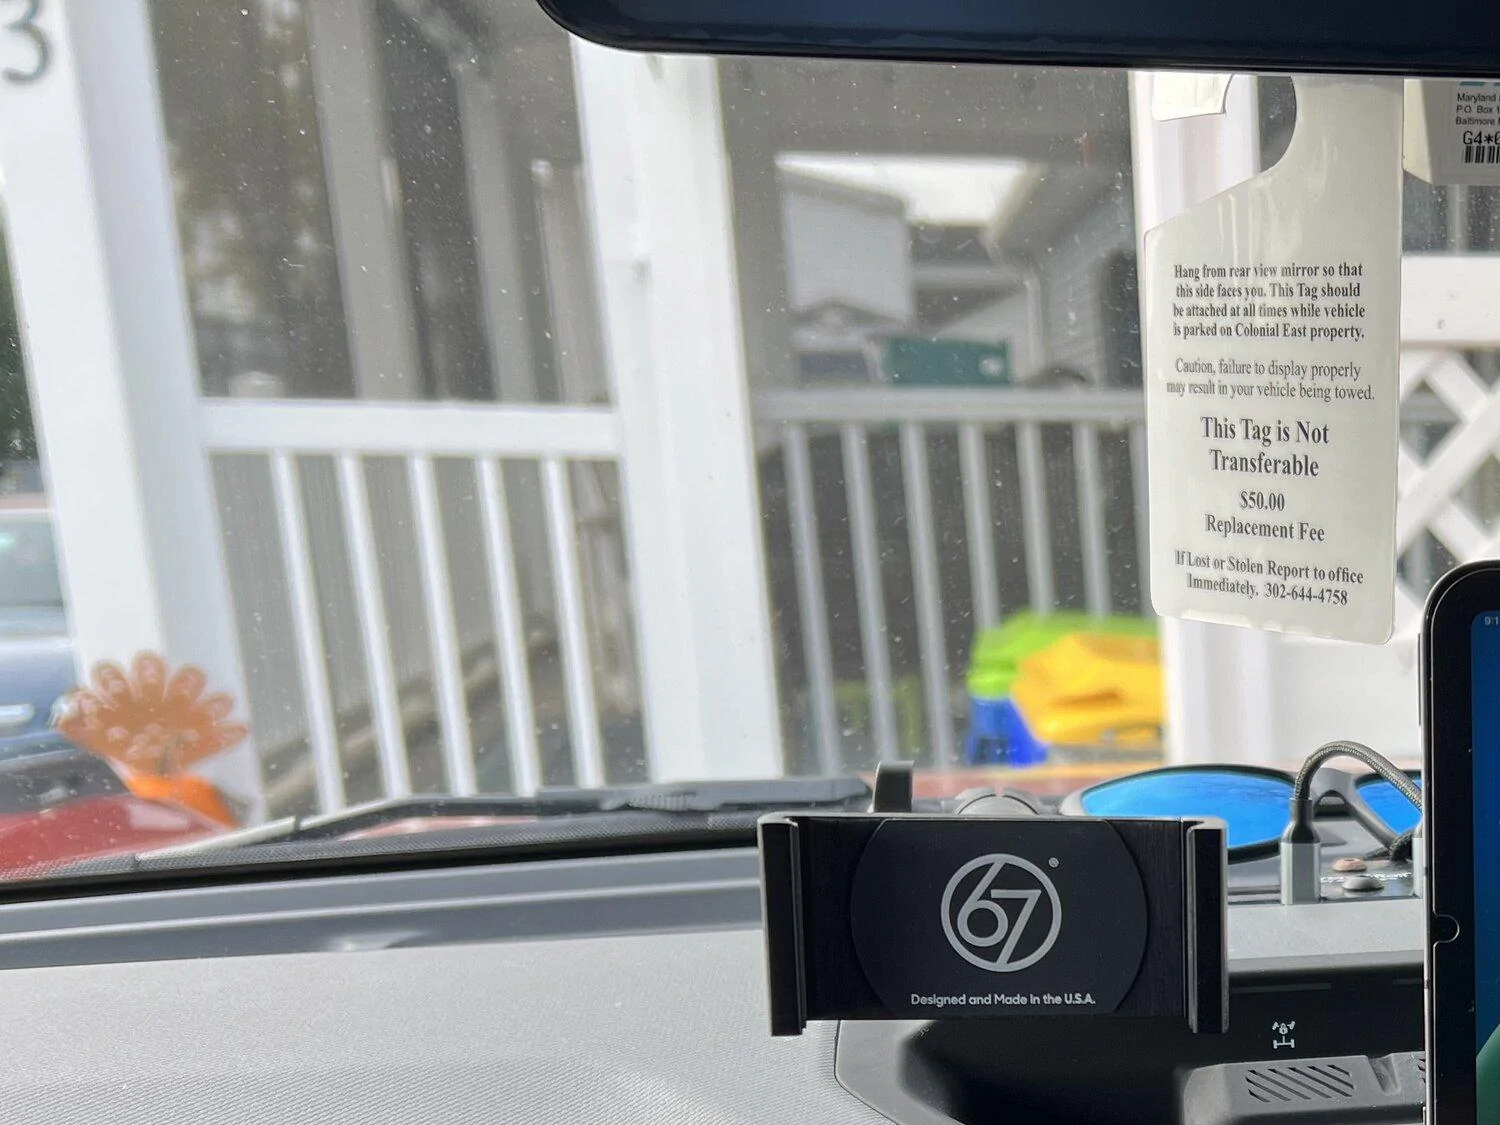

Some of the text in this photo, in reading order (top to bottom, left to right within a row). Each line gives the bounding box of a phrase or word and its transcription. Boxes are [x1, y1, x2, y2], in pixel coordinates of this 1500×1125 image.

[1457, 93, 1496, 103] Maryland
[1476, 105, 1493, 114] Box
[1455, 116, 1495, 126] Baltimore
[1174, 262, 1363, 280] Hang from rear view mirror so that
[1176, 282, 1360, 301] this side faces you. This Tag should
[1172, 303, 1365, 318] be attached at all times while vehicle
[1173, 323, 1365, 342] is parked on Colonial East property.
[1175, 358, 1361, 380] Caution, failure to display properly
[1166, 381, 1375, 402] may result in your vehicle being towed.
[1200, 416, 1330, 446] This Tag is Not
[1209, 449, 1319, 477] Transferable
[1239, 490, 1285, 512] $50.00
[1205, 513, 1325, 542] Replacement Fee
[1174, 549, 1364, 584] If Lost or Stolen Report to office
[1263, 582, 1348, 606] 302-644-4758
[952, 859, 1047, 968] 67
[910, 993, 966, 1008] Designed
[968, 994, 991, 1005] and
[994, 994, 1027, 1005] Made
[1043, 993, 1062, 1005] the
[1064, 993, 1096, 1004] U.S.A.
